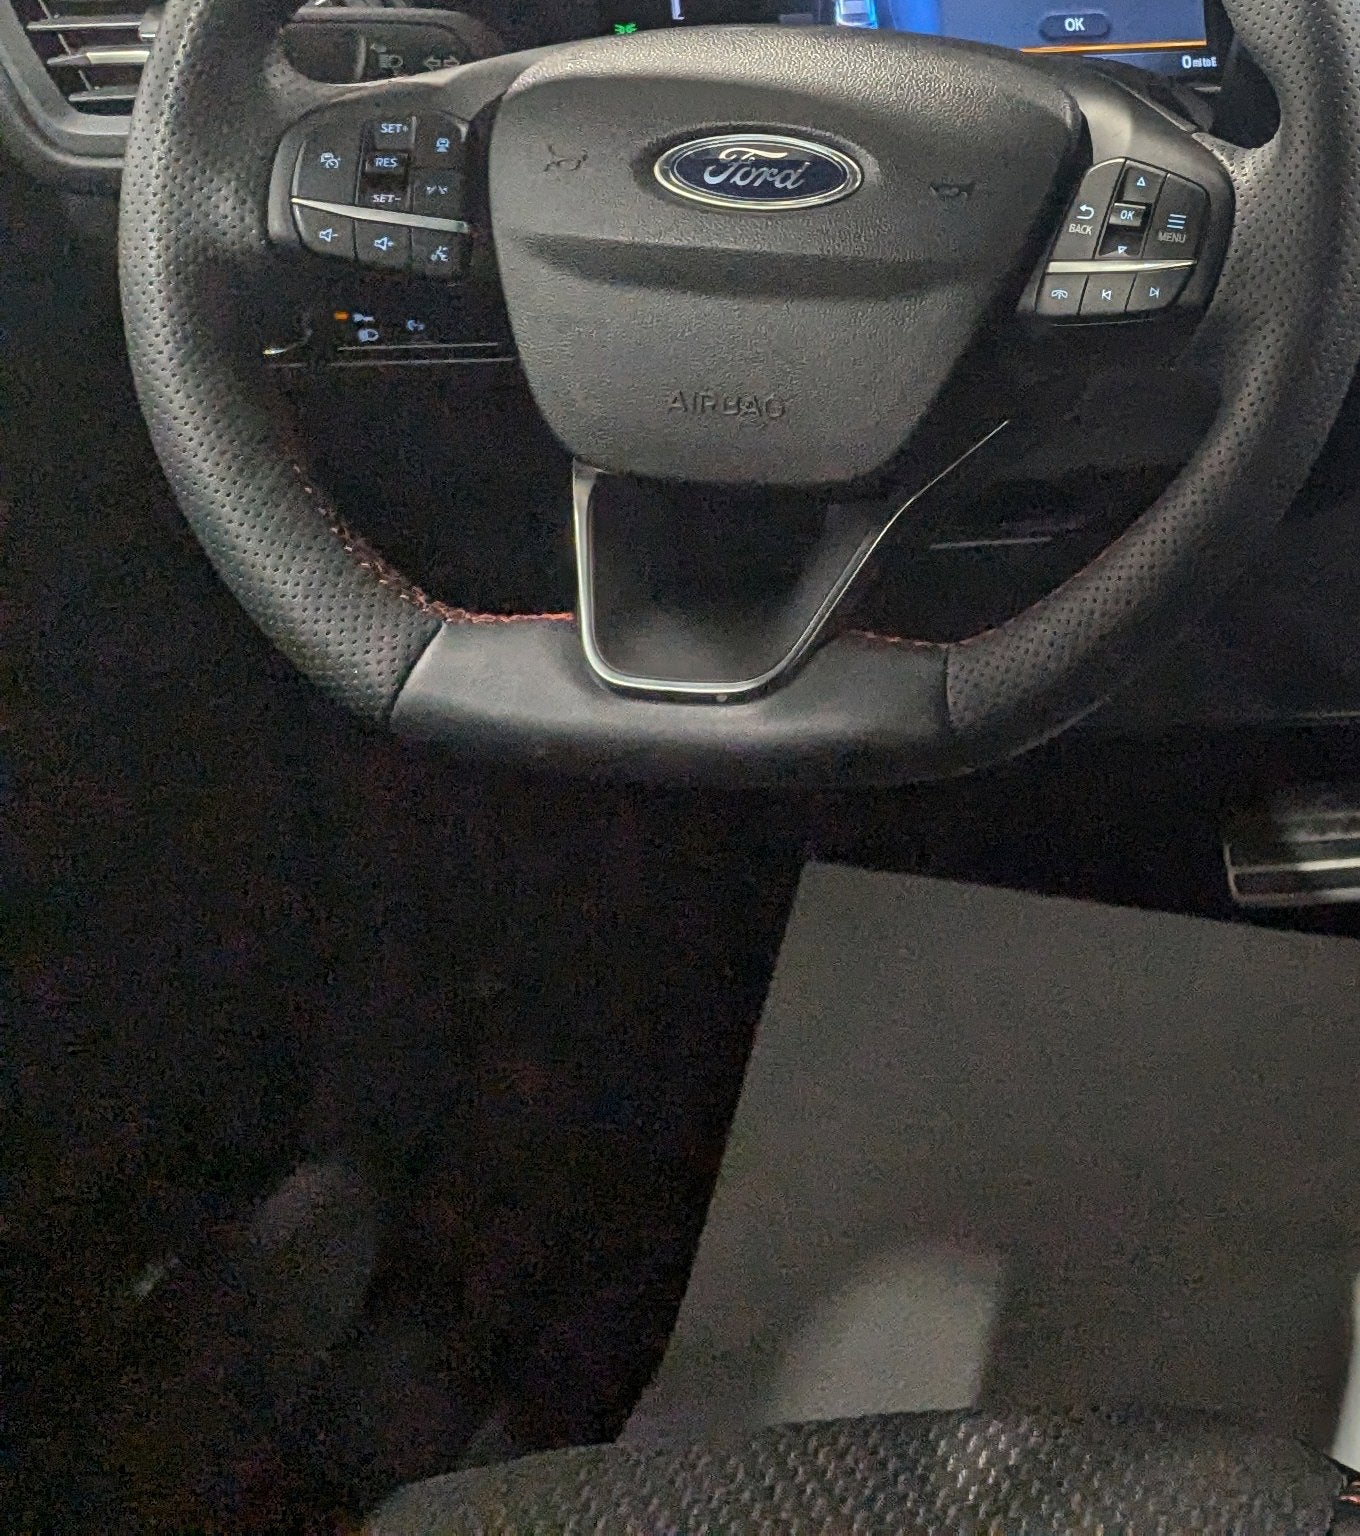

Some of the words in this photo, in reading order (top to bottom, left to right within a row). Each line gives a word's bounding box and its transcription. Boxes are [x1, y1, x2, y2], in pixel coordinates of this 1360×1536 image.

[1064, 17, 1086, 32] OK
[380, 123, 409, 134] SET+
[375, 157, 399, 168] RES
[703, 146, 811, 190] Ford
[371, 194, 402, 203] SET-
[1120, 210, 1136, 221] OK
[1068, 224, 1094, 236] BACK
[1158, 232, 1187, 244] MENU
[667, 390, 788, 419] AIRBAG
